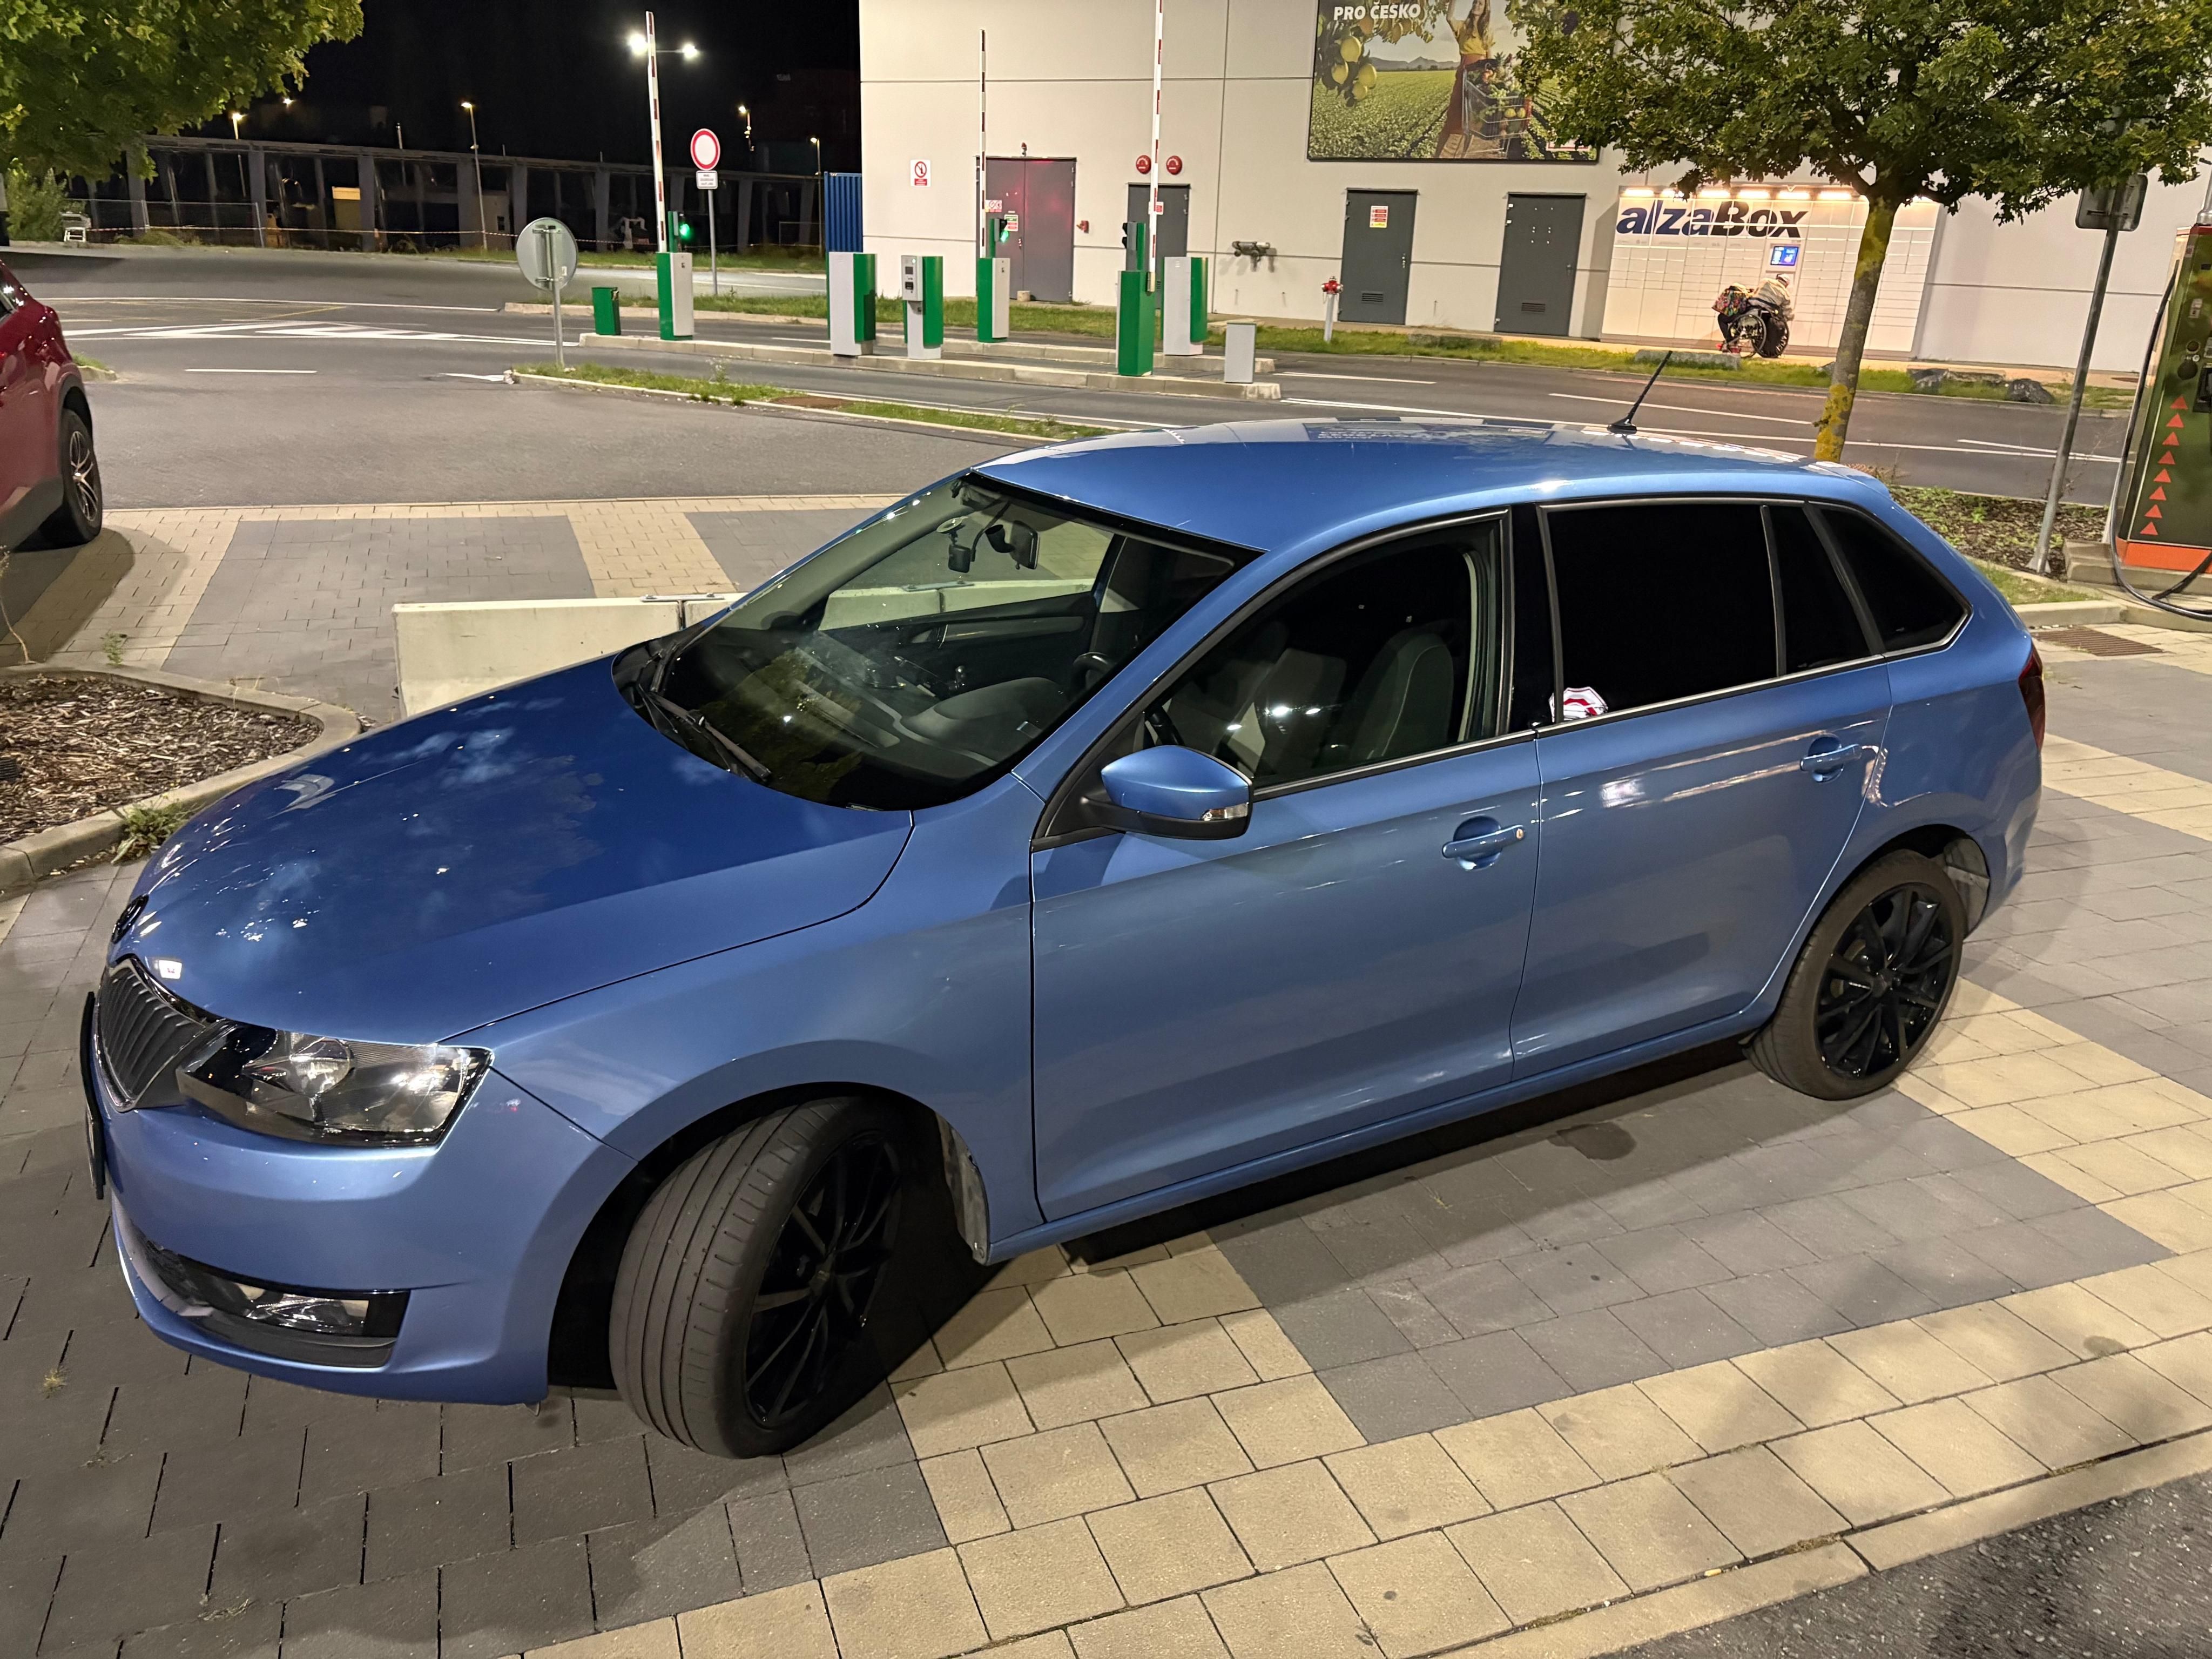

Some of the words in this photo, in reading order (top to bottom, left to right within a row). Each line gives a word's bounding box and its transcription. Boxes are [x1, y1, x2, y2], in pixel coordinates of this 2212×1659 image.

[1333, 5, 1366, 21] PRO
[1370, 1, 1421, 19] ČESKO
[1616, 199, 1809, 238] alzaBox
